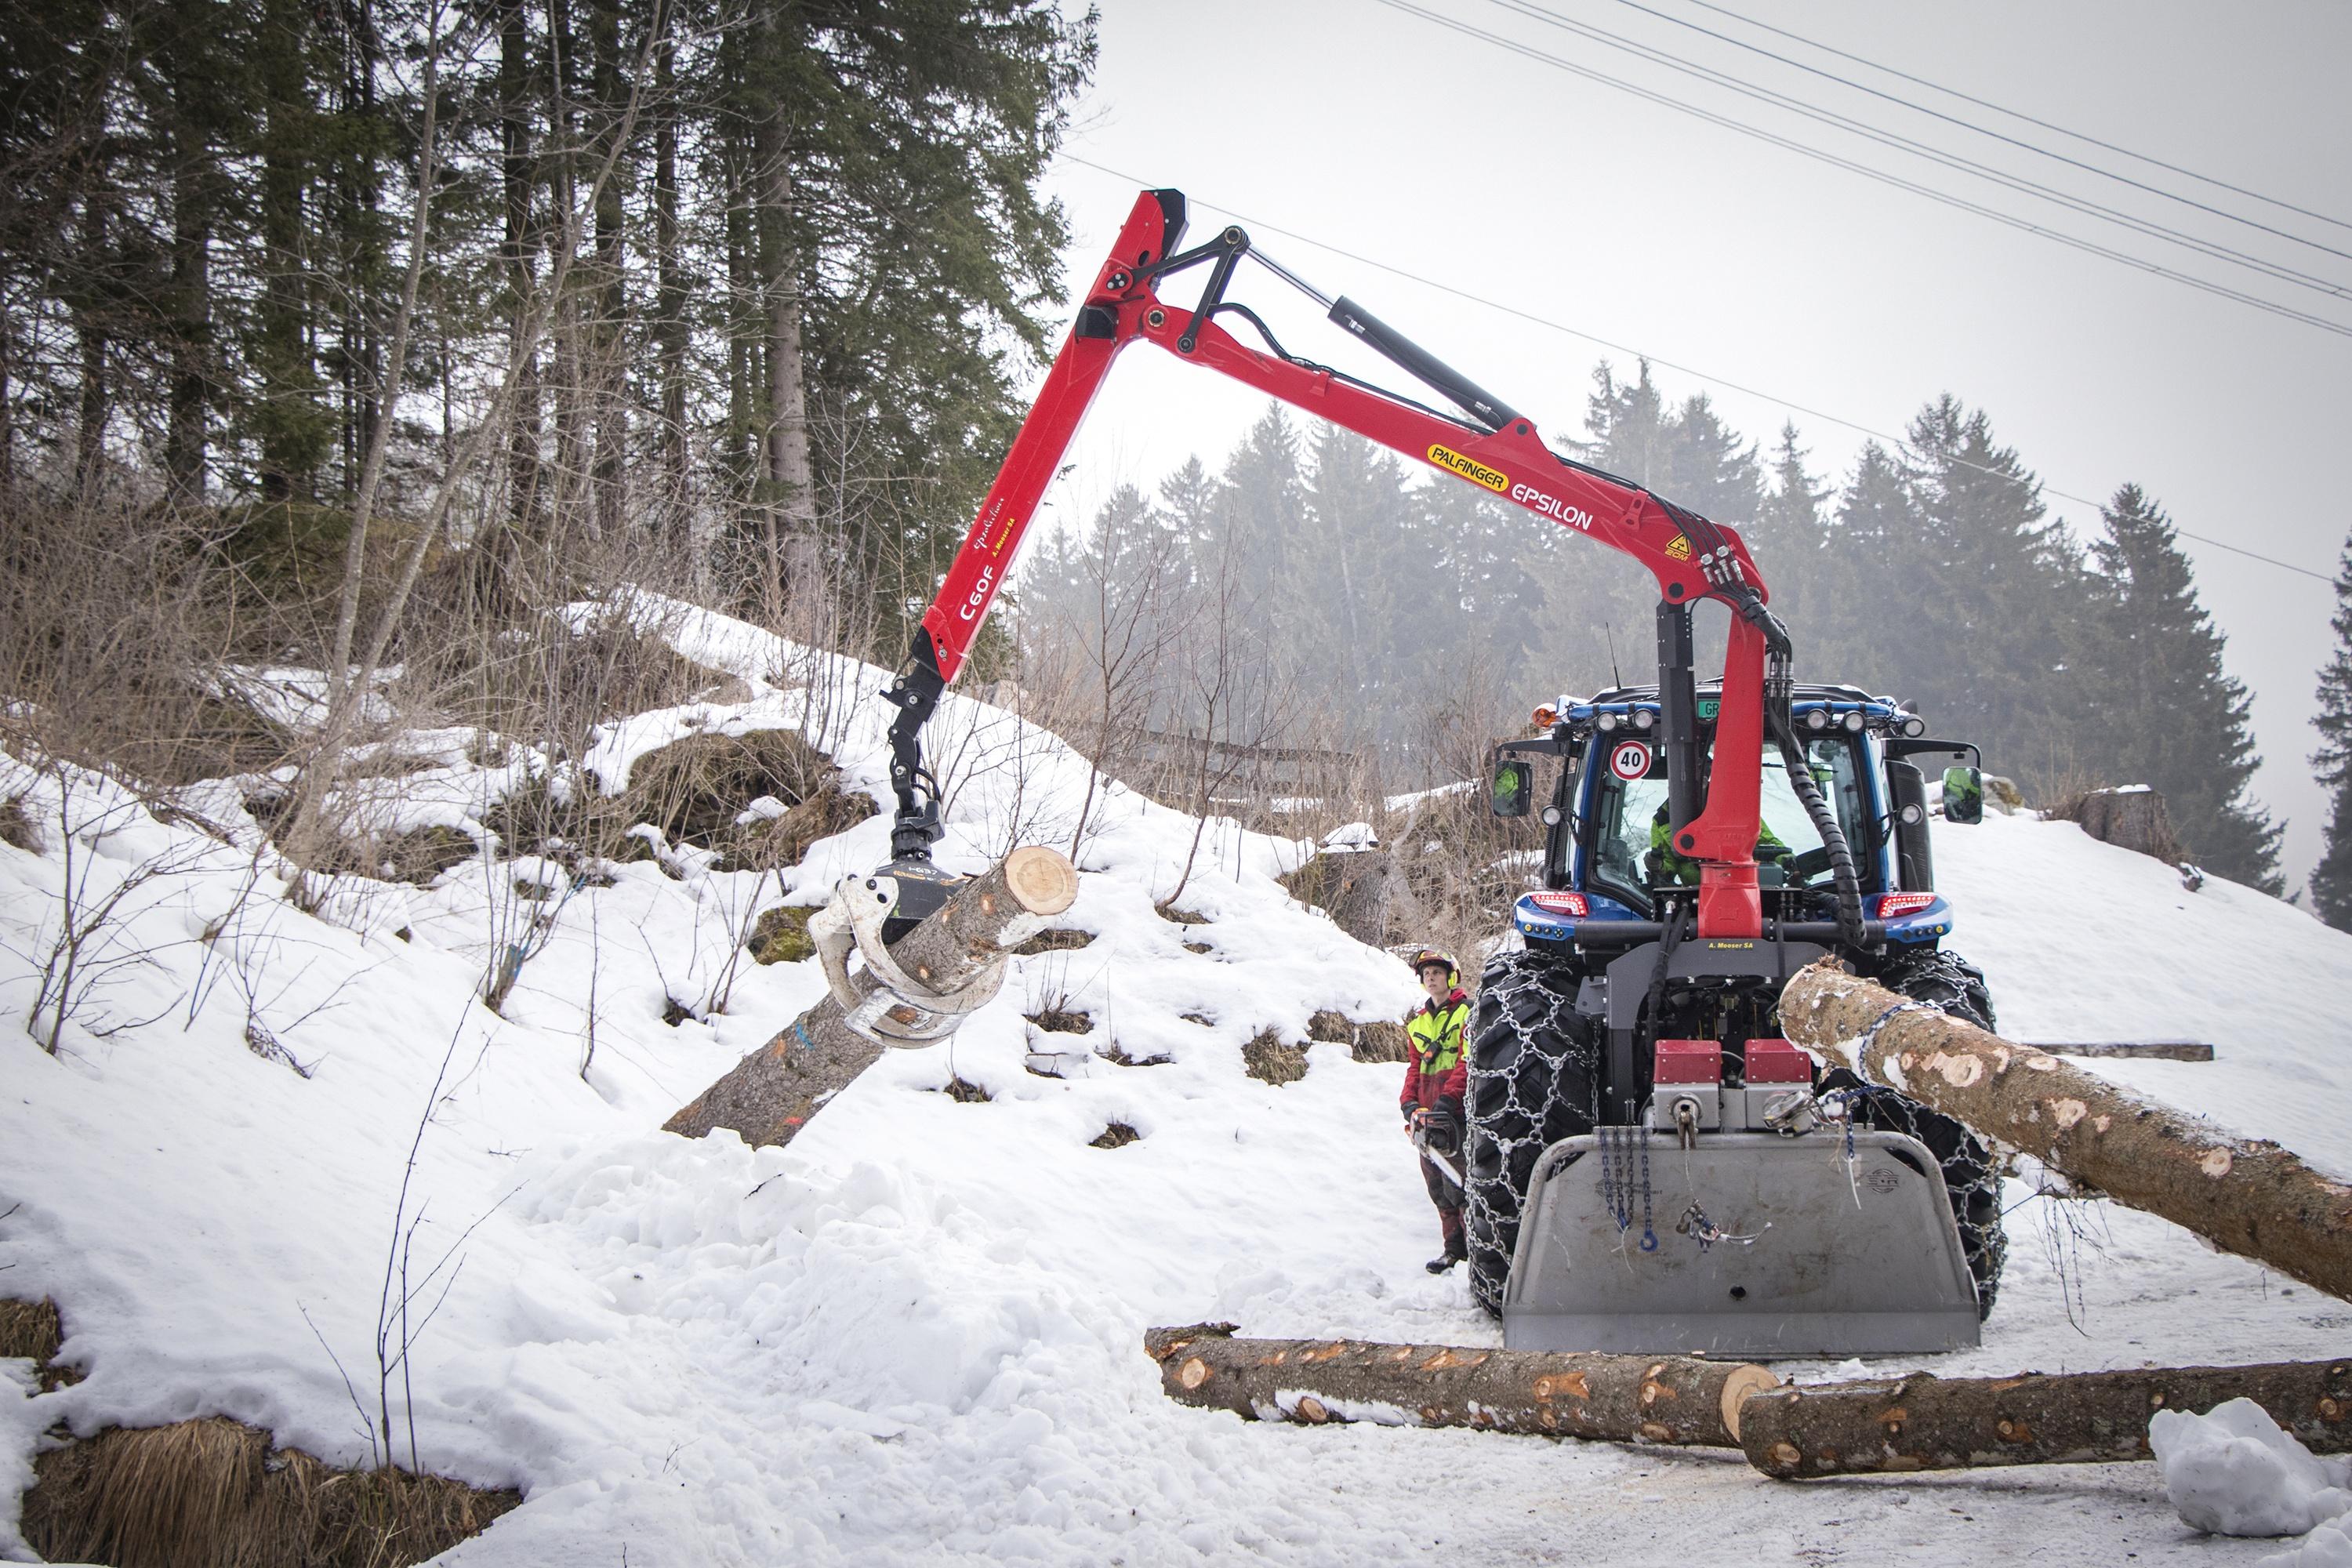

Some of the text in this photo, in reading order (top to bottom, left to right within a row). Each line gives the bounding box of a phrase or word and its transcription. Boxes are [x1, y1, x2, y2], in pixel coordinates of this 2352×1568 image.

[1432, 448, 1504, 488] PALFINGER
[1512, 483, 1593, 531] EPSILON
[996, 527, 1011, 550] Mooser
[1007, 517, 1015, 528] SA
[1621, 751, 1641, 768] 40
